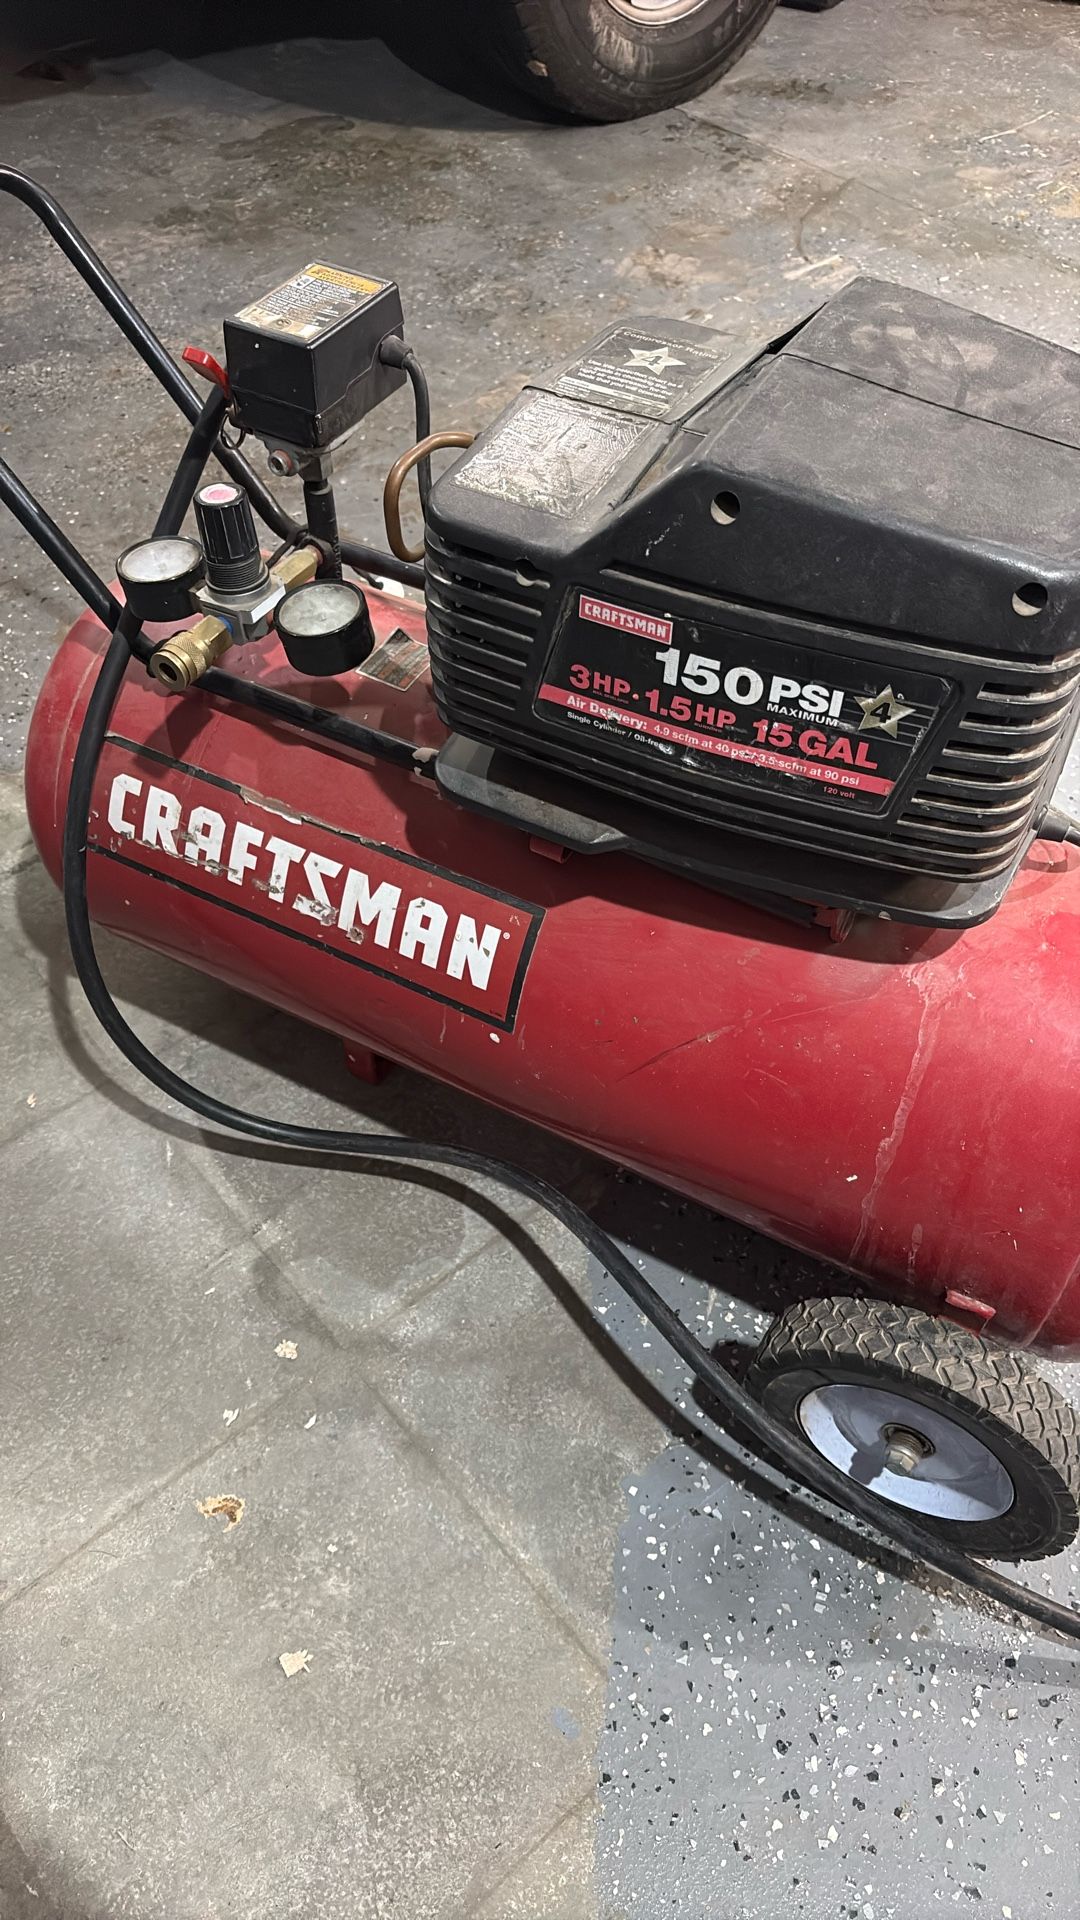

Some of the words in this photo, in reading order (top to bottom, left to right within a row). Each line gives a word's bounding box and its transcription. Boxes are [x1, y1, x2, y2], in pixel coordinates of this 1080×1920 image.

[623, 331, 684, 349] Compressor
[685, 346, 720, 360] Rating
[641, 355, 663, 366] 4
[648, 376, 667, 385] chart
[584, 603, 667, 638] CRAFTSMAN
[769, 675, 845, 718] PSI
[567, 711, 591, 724] Single
[593, 720, 627, 736] Cylinder
[766, 702, 839, 728] MAXIMUM
[870, 702, 892, 723] 4
[567, 695, 587, 709] Air
[653, 724, 670, 737] 4.9
[671, 730, 699, 745] scfm
[701, 740, 713, 749] at
[715, 743, 730, 753] 40
[758, 753, 776, 766] 3.5
[778, 760, 807, 774] scfm
[809, 766, 822, 777] at
[824, 770, 839, 781] 90
[840, 773, 860, 786] psi
[798, 729, 878, 770] GAL
[823, 785, 838, 796] 120
[839, 789, 856, 800] volt
[108, 773, 503, 991] CRAFTSMAN
